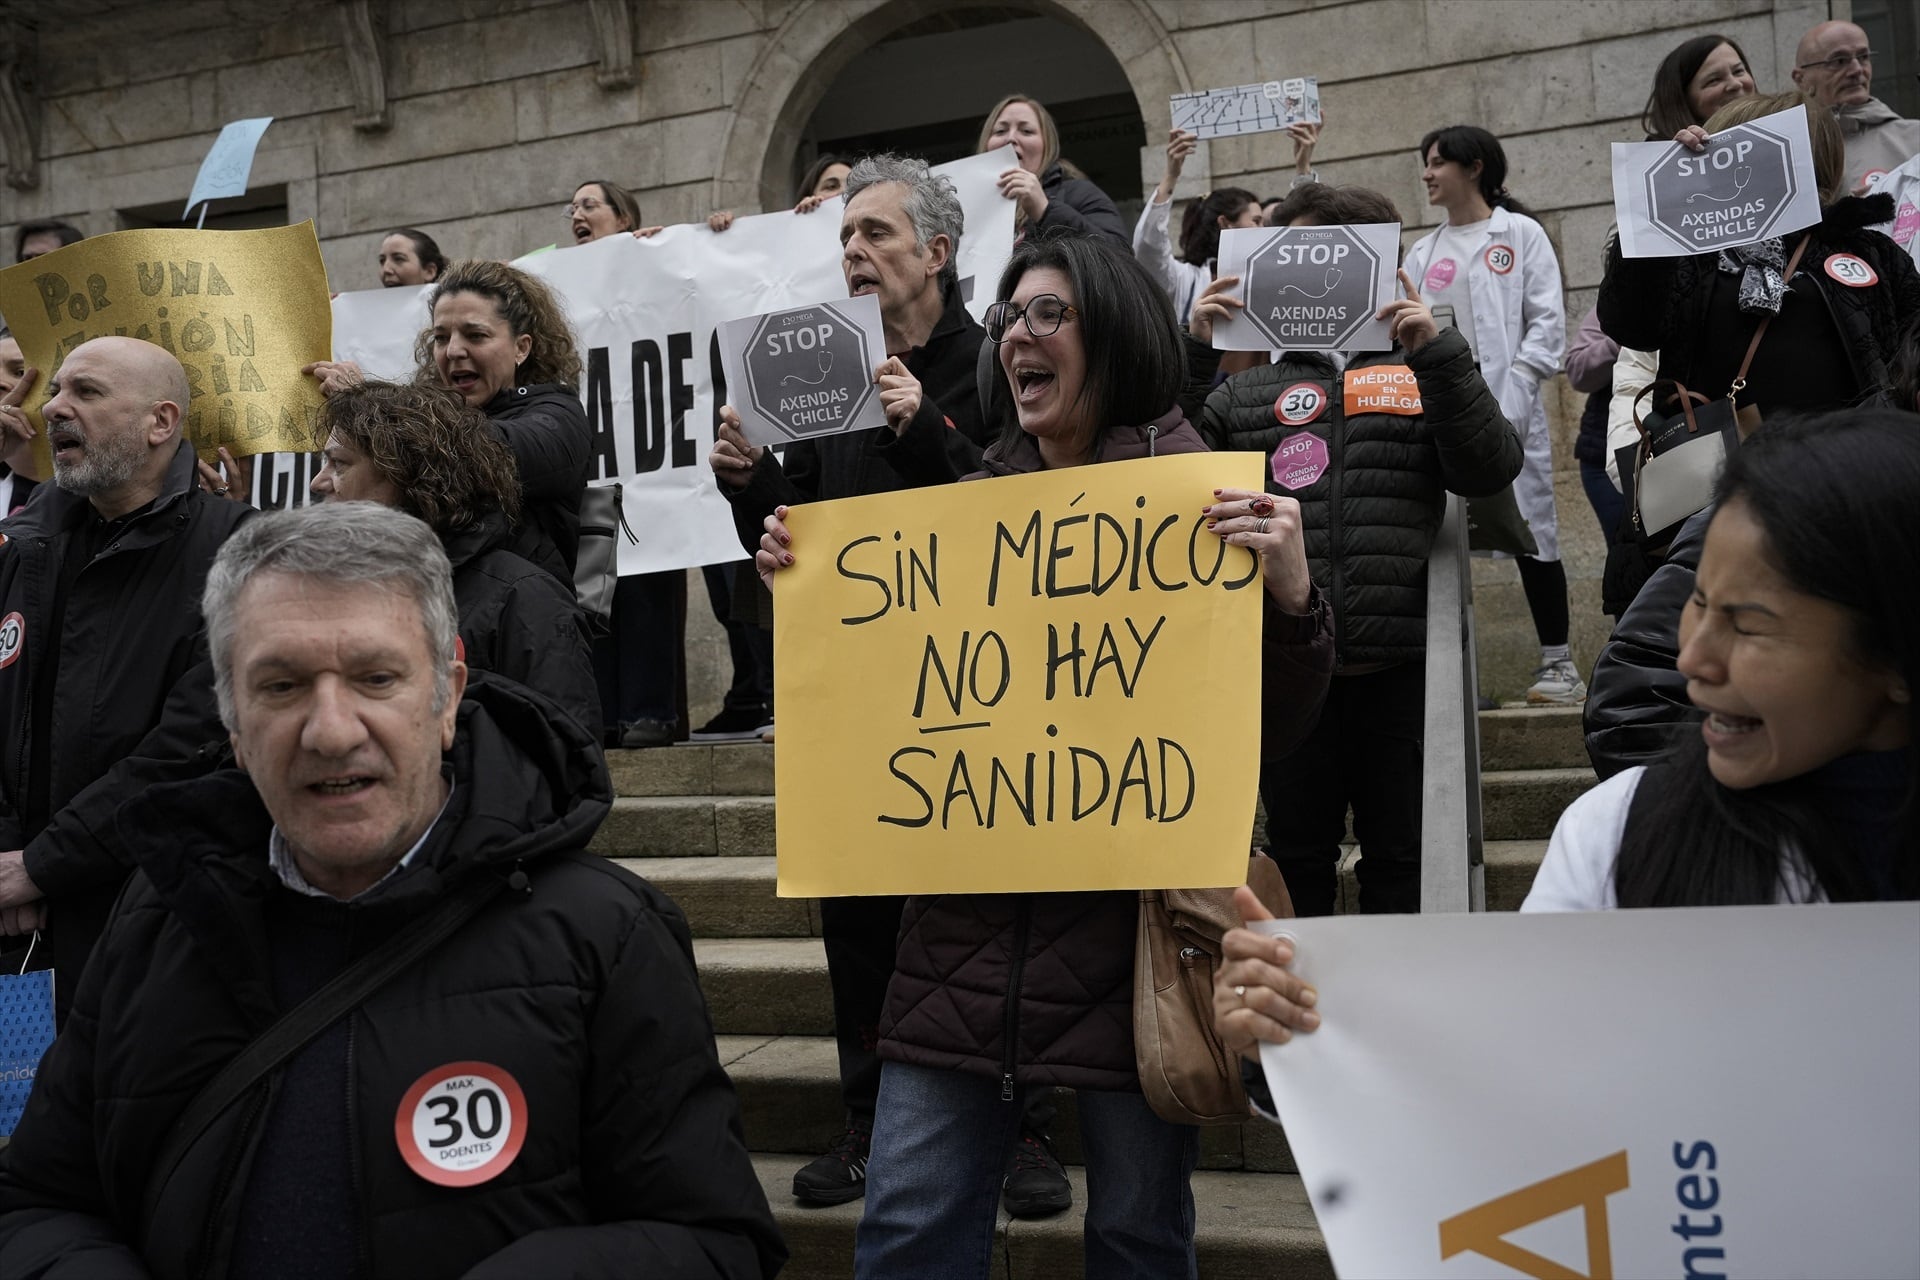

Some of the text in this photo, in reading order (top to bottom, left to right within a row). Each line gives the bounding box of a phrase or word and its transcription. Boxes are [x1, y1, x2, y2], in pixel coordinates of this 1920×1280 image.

[1677, 140, 1753, 177] STOP
[1680, 198, 1766, 227] AXENDAS
[1693, 217, 1757, 241] CHICLE
[1277, 244, 1350, 265] STOP
[1491, 251, 1510, 266] 30
[1834, 262, 1867, 278] 30
[34, 260, 234, 326] POR UNA
[1270, 306, 1347, 320] AXENDAS
[766, 324, 833, 356] STOP
[1280, 323, 1336, 336] CHICLE
[631, 331, 697, 474] DE
[780, 388, 849, 412] AXENDAS
[1285, 393, 1317, 411] 30
[1357, 396, 1422, 409] HUELGA
[791, 405, 843, 426] CHICLE
[1283, 440, 1313, 458] STOP
[1286, 464, 1319, 480] AXENDAS
[1291, 472, 1316, 484] CHICLE
[837, 492, 1259, 625] SIN MÉDICOS
[912, 615, 1166, 718] NO HAY
[877, 724, 1195, 830] SANIDAD
[446, 1079, 474, 1092] MAX
[425, 1087, 502, 1148] 30
[440, 1141, 493, 1160] DOENTES
